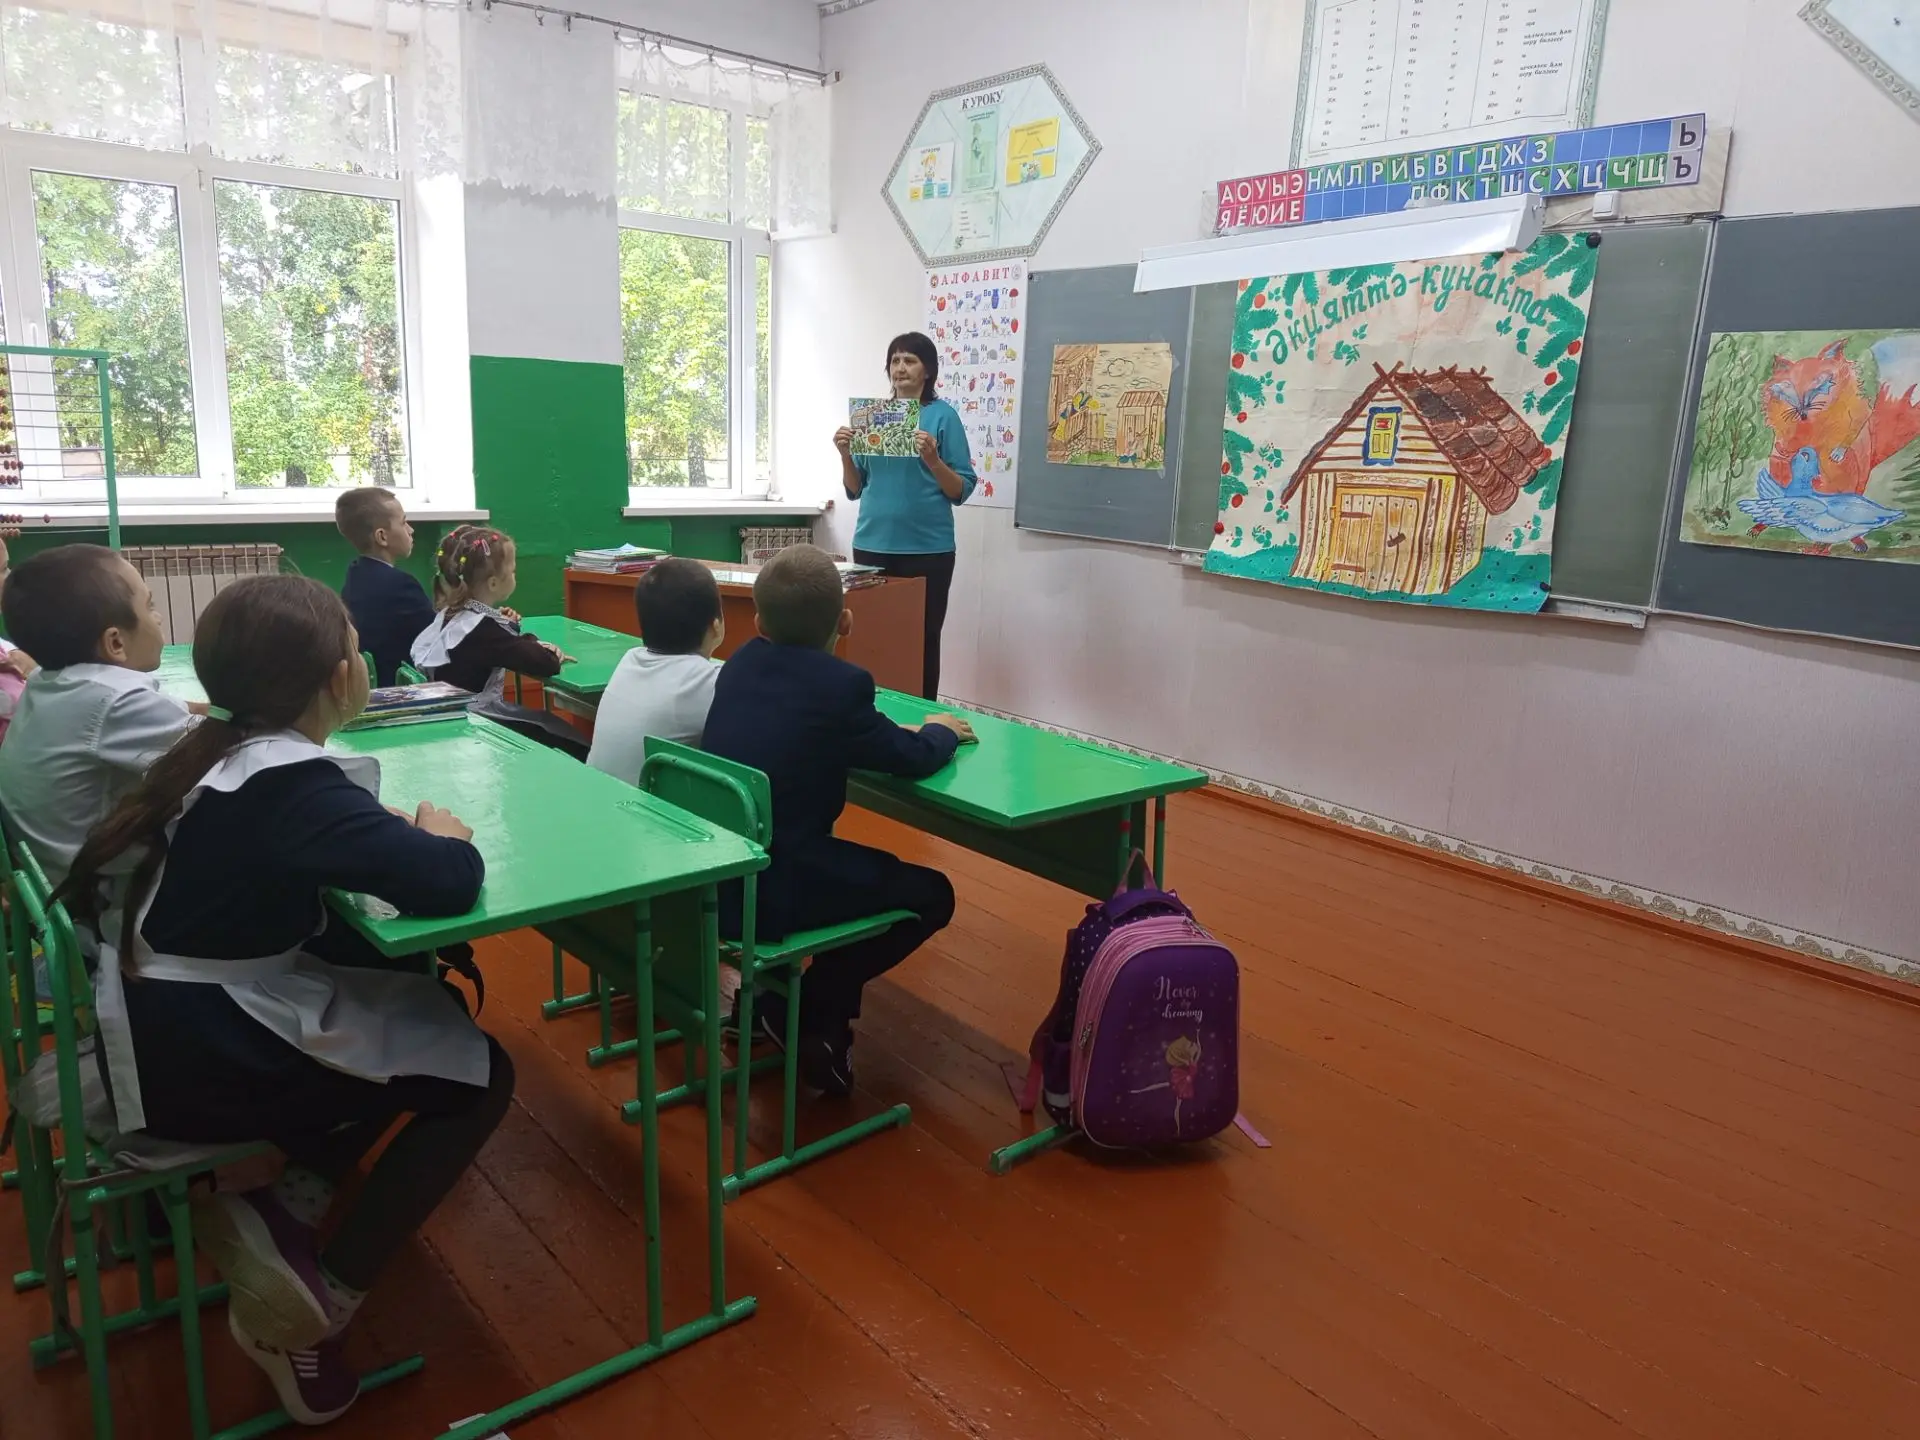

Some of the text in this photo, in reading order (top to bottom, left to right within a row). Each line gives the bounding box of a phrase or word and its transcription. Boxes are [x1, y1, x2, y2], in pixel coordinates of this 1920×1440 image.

[962, 90, 1003, 111] К УРОКУ
[941, 267, 1010, 286] АЛФАВИТ
[1153, 975, 1200, 1001] Never
